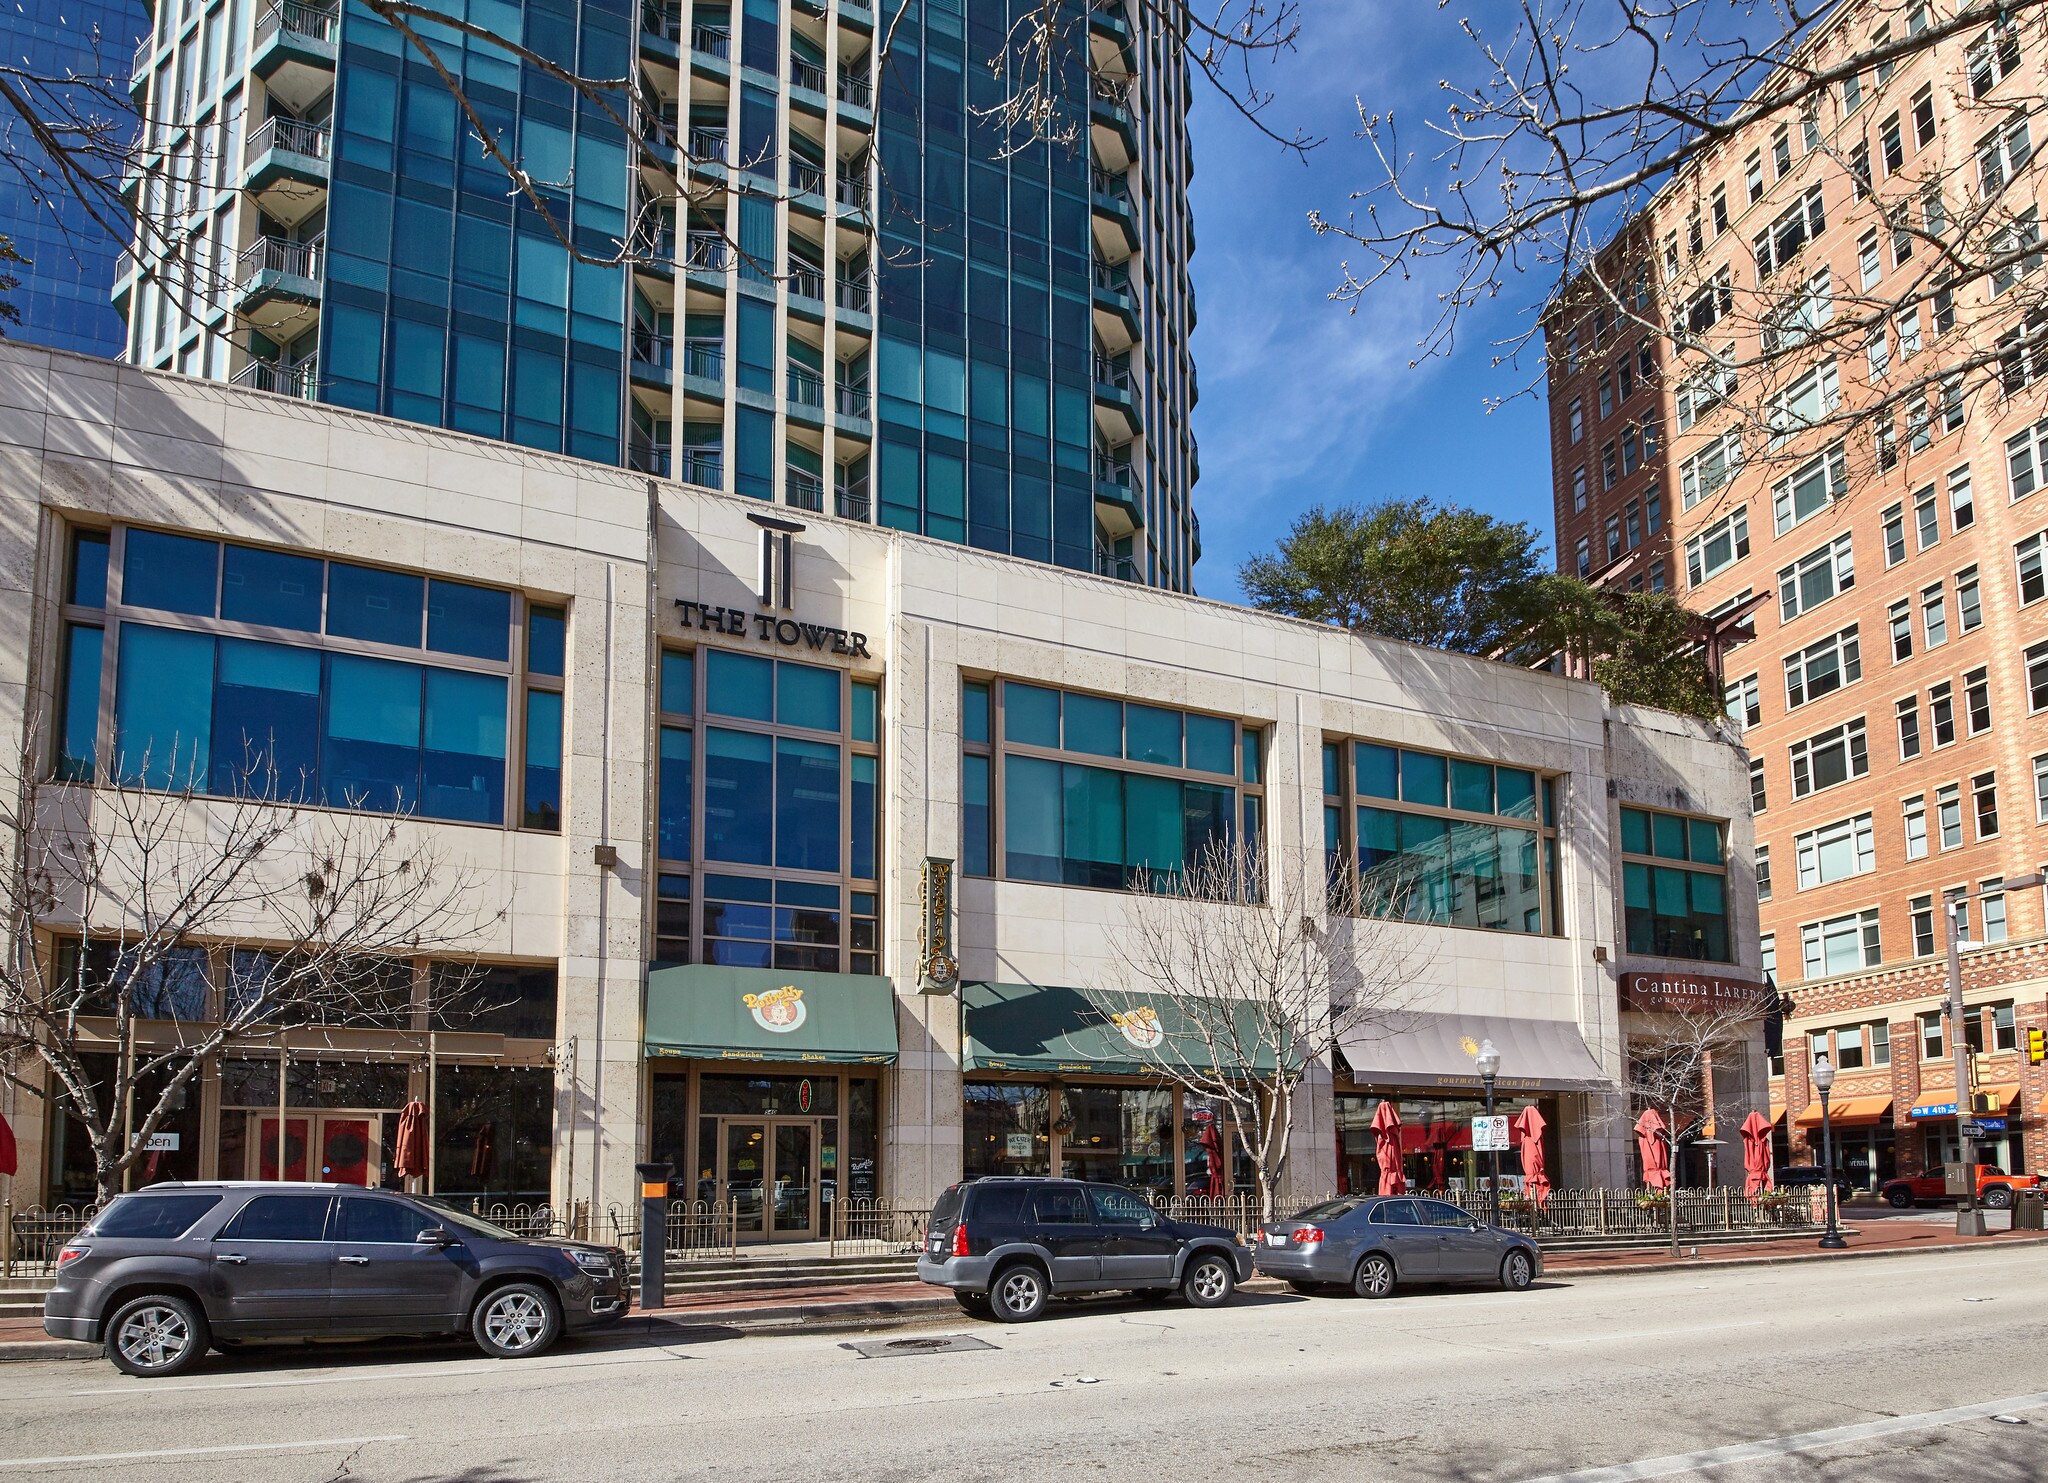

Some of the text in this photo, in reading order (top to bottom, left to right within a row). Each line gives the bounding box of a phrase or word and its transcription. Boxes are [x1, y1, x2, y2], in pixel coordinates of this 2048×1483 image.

[674, 598, 871, 660] THE TOWER
[1635, 977, 1764, 1001] Cantina LAREDO
[742, 985, 804, 1009] Potbelly
[1650, 996, 1697, 1006] gourmet
[658, 1047, 681, 1056] Soups
[721, 1050, 764, 1058] Sandwiches
[801, 1053, 826, 1061] Shakes
[1437, 1076, 1476, 1086] gourmet
[1520, 1078, 1542, 1089] food
[1921, 1106, 1929, 1115] W
[1931, 1105, 1947, 1114] 4th
[145, 1138, 171, 1149] pen
